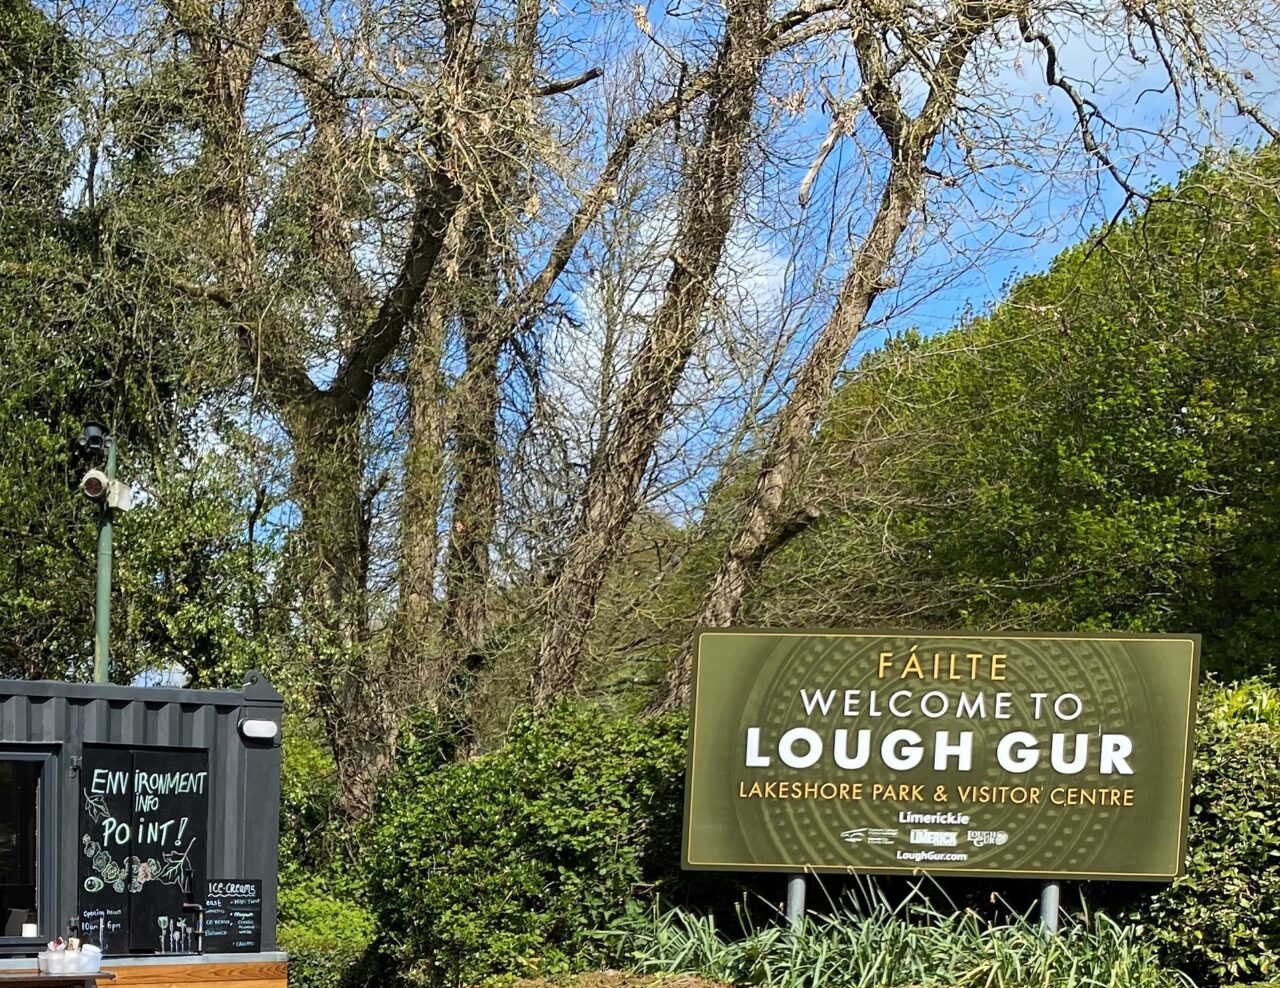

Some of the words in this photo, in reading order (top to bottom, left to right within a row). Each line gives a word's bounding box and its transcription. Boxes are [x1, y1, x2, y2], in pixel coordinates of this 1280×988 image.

[878, 645, 1008, 681] FÁILTE
[799, 688, 1012, 719] WELCOME
[1030, 693, 1083, 720] TO
[745, 726, 974, 772] LOUGH
[996, 731, 1134, 775] GUR
[739, 781, 863, 800] LAKESHORE
[872, 784, 925, 801] PARK
[933, 785, 948, 803] &
[957, 785, 1040, 804] VISITOR
[1050, 788, 1134, 806] CENTRE
[898, 811, 970, 825] Limerick.ie
[911, 830, 957, 845] LIMERICK
[896, 850, 967, 862] LoughGur.com
[206, 899, 222, 907] east
[107, 920, 121, 932] 6pm
